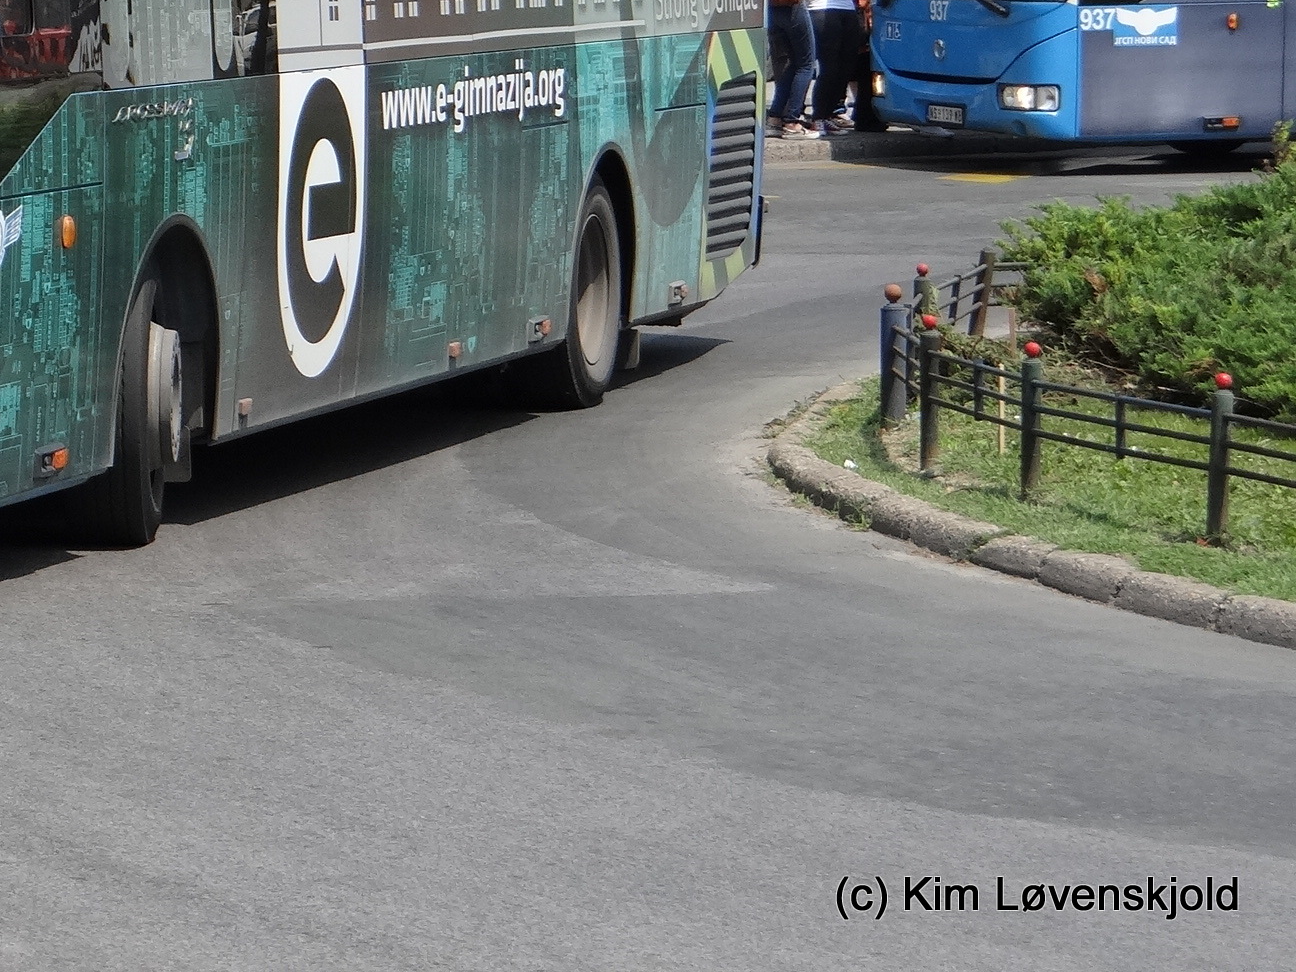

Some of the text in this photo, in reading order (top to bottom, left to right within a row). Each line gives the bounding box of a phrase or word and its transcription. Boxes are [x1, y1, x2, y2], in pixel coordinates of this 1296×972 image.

[929, 0, 950, 21] 937
[1079, 8, 1116, 31] 937
[1134, 36, 1158, 45] НОВИ
[1159, 35, 1177, 46] САД
[381, 58, 565, 133] www.e-gimnazija.org
